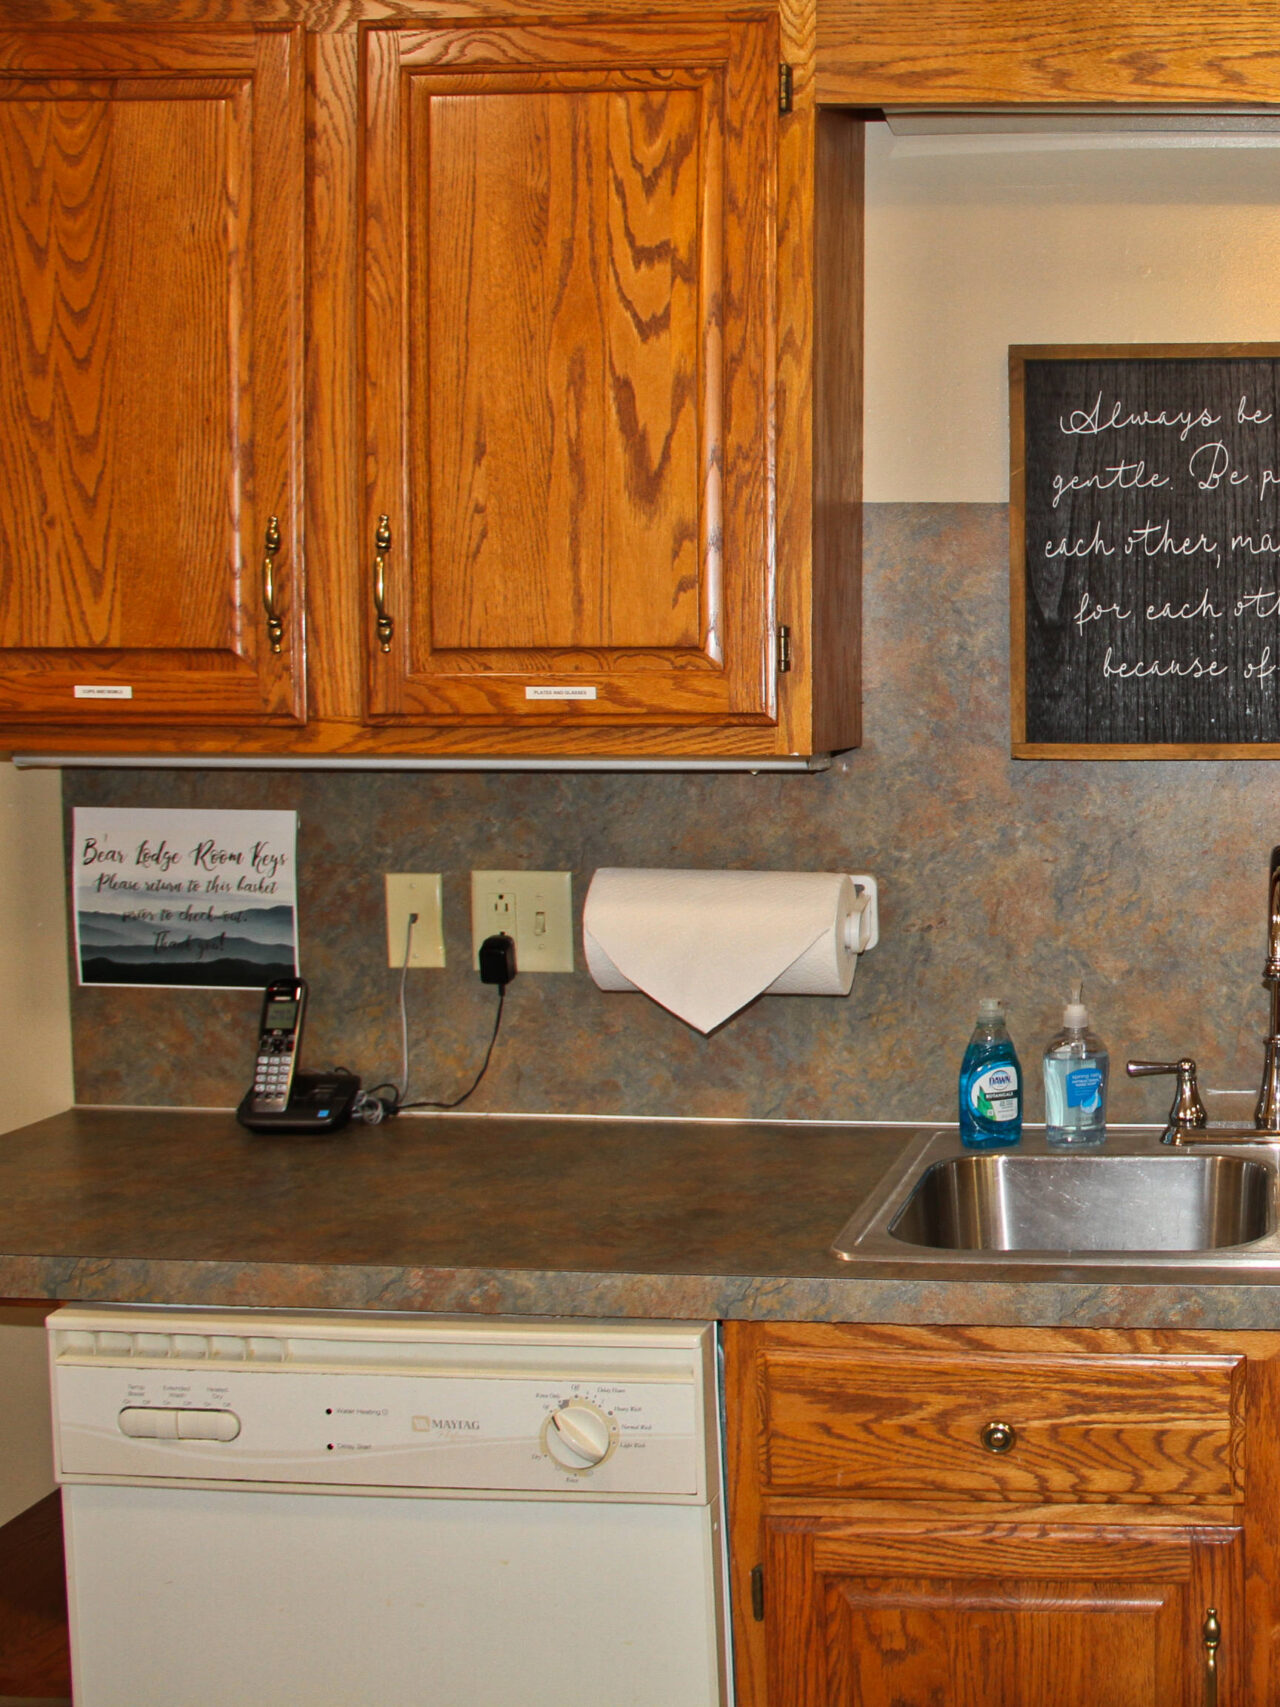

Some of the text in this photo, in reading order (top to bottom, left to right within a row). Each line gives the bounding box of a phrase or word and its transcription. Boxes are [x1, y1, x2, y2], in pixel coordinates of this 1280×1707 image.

[1059, 391, 1221, 440] Always
[1237, 396, 1272, 424] be
[1052, 459, 1173, 507] gentle.
[1189, 440, 1248, 489] Be
[1044, 521, 1115, 559] each
[1125, 519, 1222, 568] other,
[1074, 593, 1131, 636] for
[1146, 588, 1222, 620] each
[1103, 646, 1228, 678] because
[1243, 646, 1273, 689] of
[83, 838, 288, 879] Bear Lodge Room Keys
[95, 873, 279, 894] Please return to this basket
[160, 908, 174, 921] to
[153, 931, 192, 954] Thank
[989, 1075, 1012, 1086] DAWN
[431, 1418, 480, 1430] MAYTAG
